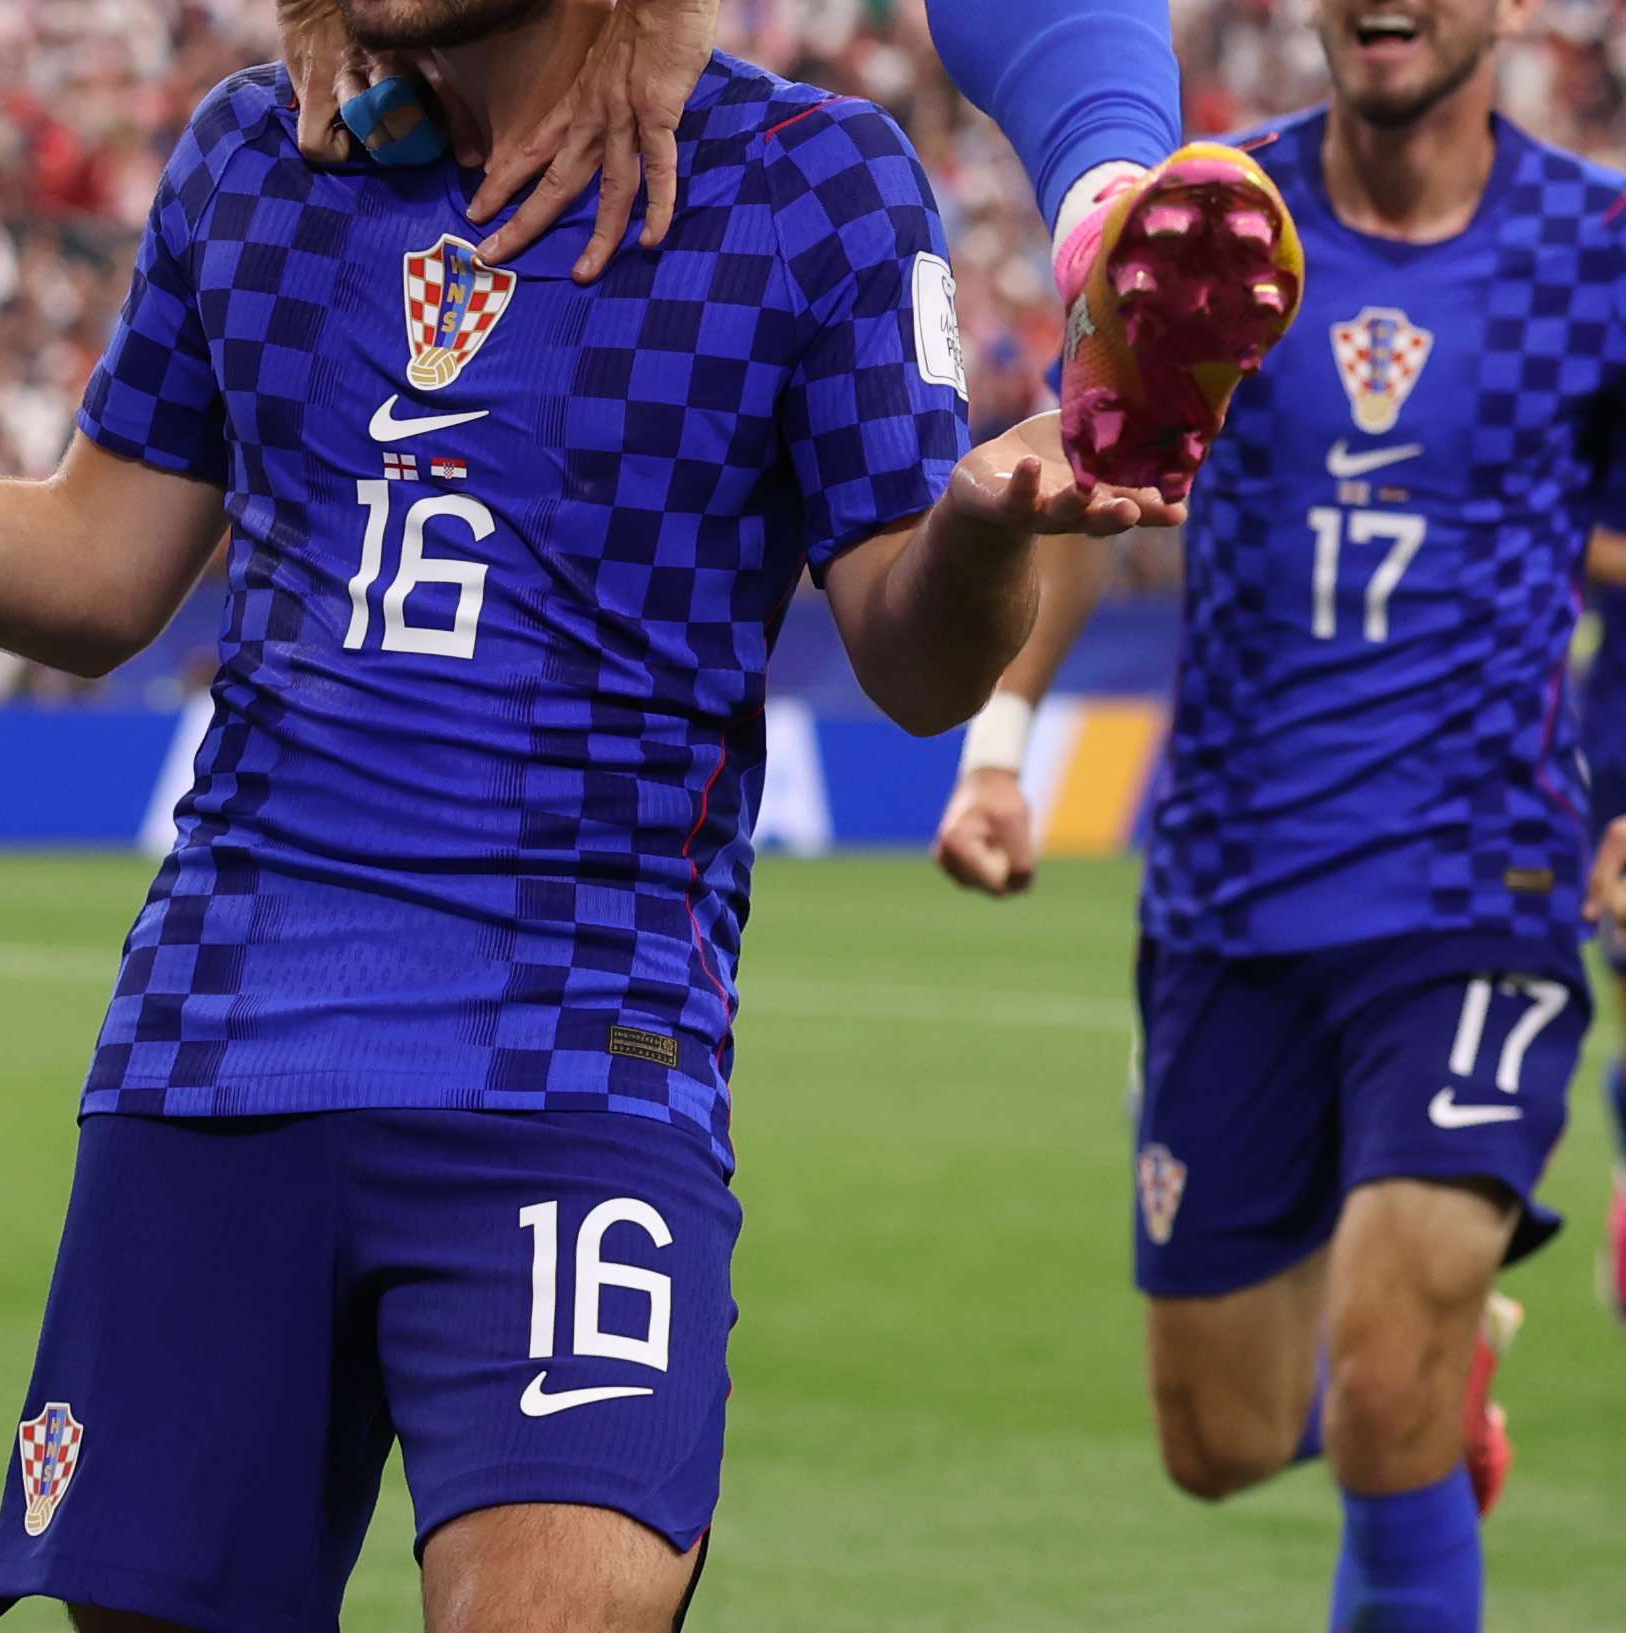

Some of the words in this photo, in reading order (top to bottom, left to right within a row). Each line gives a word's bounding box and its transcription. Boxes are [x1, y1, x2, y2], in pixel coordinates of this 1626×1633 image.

[342, 478, 496, 660] 16
[1306, 505, 1427, 644] 17
[1448, 977, 1570, 1095] 17
[519, 1196, 674, 1373] 16
